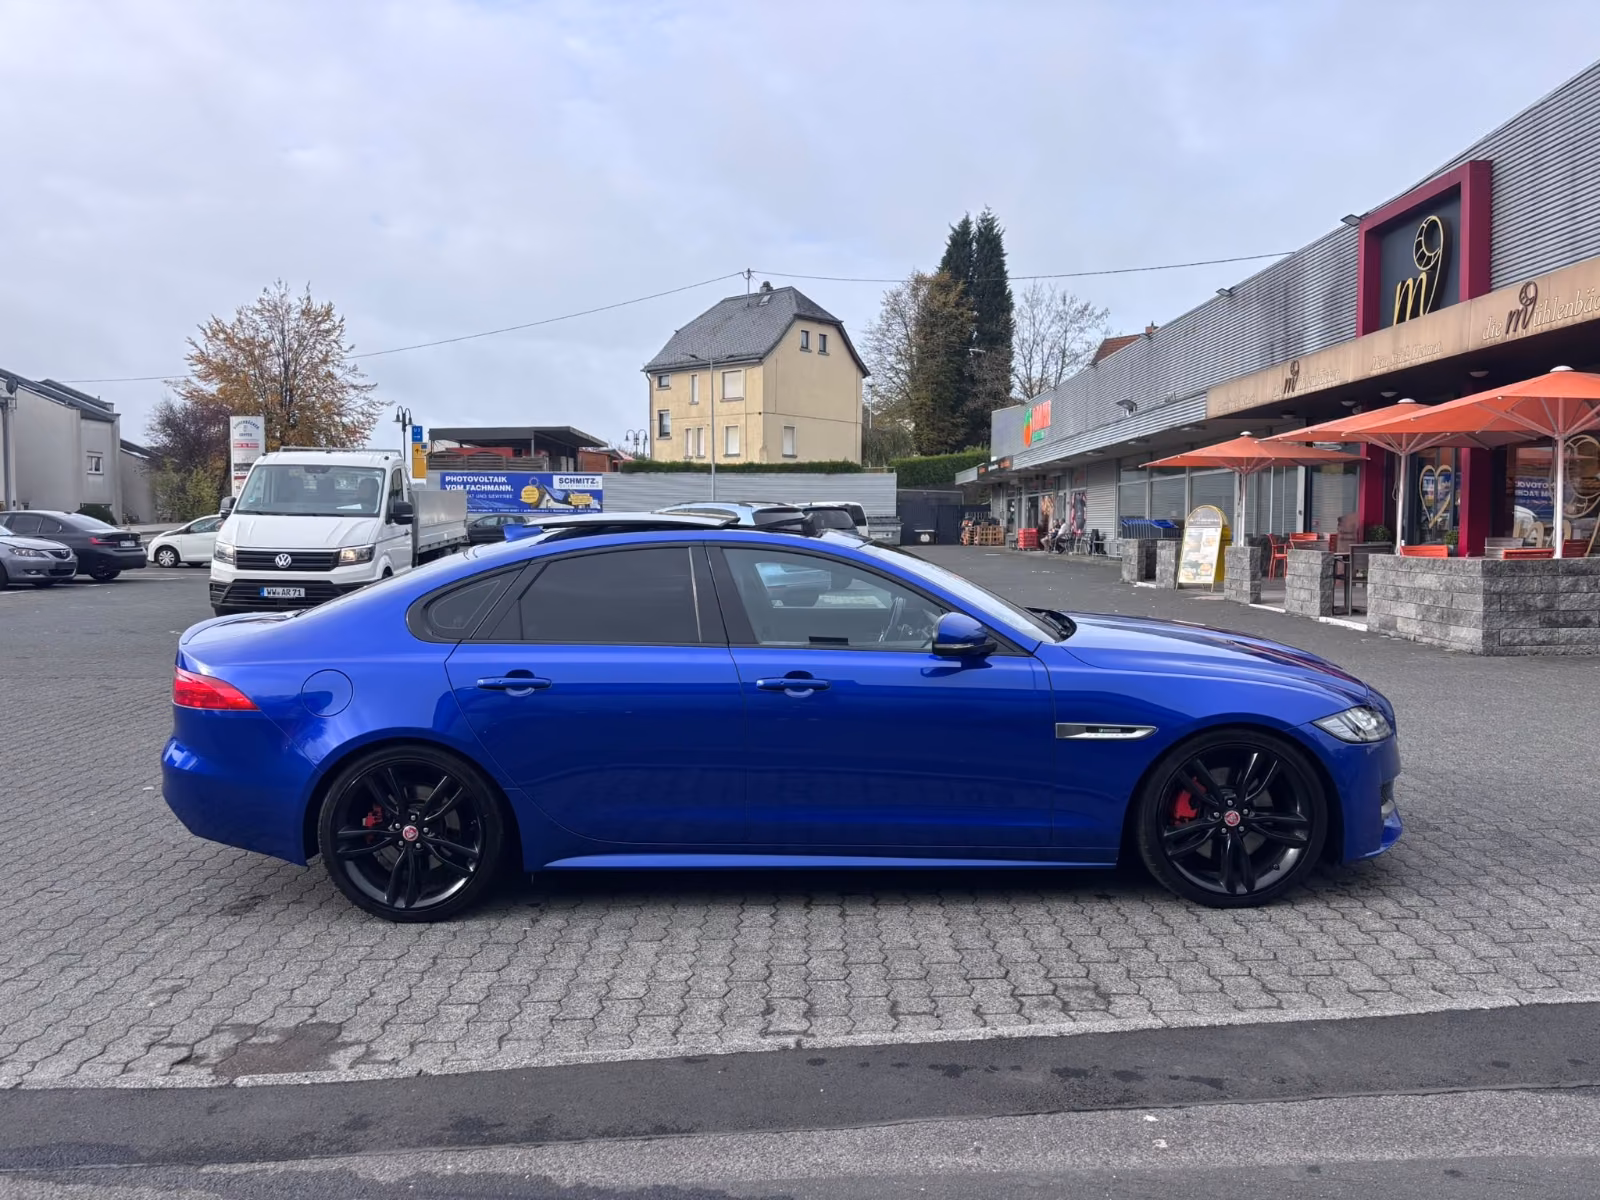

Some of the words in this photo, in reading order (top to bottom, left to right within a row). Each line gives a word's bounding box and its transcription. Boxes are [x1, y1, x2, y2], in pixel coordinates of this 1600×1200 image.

[1482, 316, 1502, 340] die
[445, 475, 507, 483] PHOTOVOLTAIK
[558, 477, 596, 485] SCHMITZ
